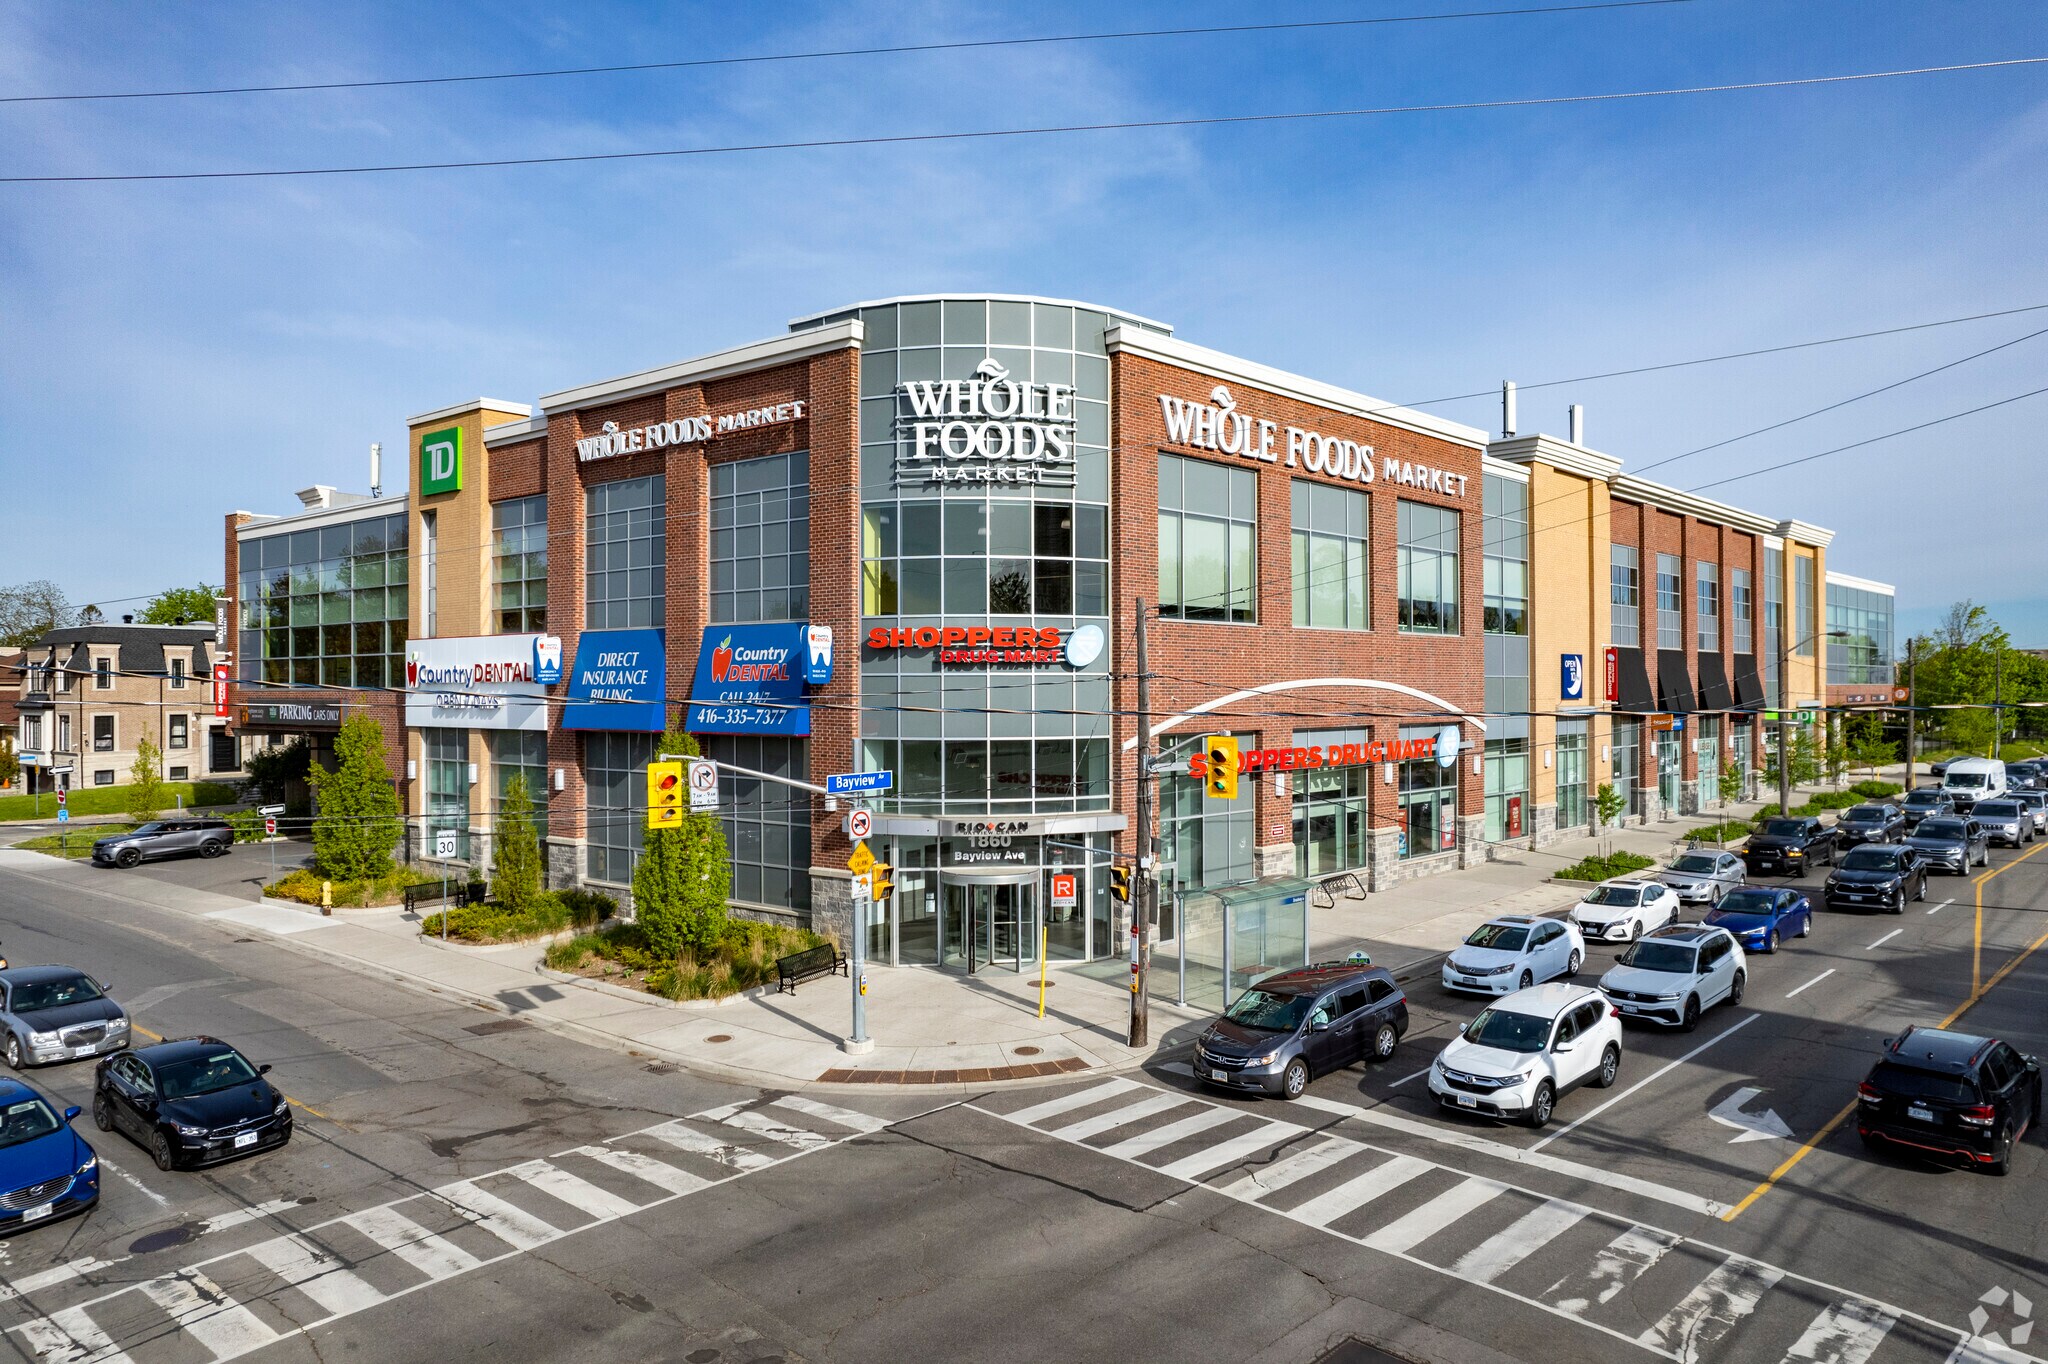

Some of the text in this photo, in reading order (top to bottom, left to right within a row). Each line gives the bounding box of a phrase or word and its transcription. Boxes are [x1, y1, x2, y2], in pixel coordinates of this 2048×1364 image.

[903, 368, 1072, 420] WHOLE
[576, 401, 805, 462] WHOLE FOODS MARKET
[913, 420, 1068, 461] FOODS
[1159, 390, 1468, 497] WHOLE FOODS MARKET
[425, 441, 454, 481] TD
[932, 466, 1046, 481] MARKET
[867, 626, 1060, 649] SHOPPERS
[597, 652, 639, 667] DIRECT
[735, 647, 788, 663] Country
[941, 649, 1061, 664] DRUG MART
[418, 665, 473, 688] Country
[474, 662, 532, 683] DENTAL
[582, 670, 648, 685] INSURANCE
[728, 663, 789, 682] DENTAL
[590, 688, 632, 703] BILLING
[720, 691, 770, 704] CALL 24/7
[279, 705, 312, 720] PARKING
[313, 710, 326, 720] CARS
[326, 710, 340, 720] ONLY
[697, 708, 788, 724] 416-335-7377
[1188, 737, 1436, 779] SPPERS DRUG MART
[836, 775, 875, 790] Bayview
[439, 841, 453, 853] 30
[968, 836, 1012, 848] 1860
[954, 851, 1025, 862] Bayview Ave
[1057, 881, 1070, 894] R
